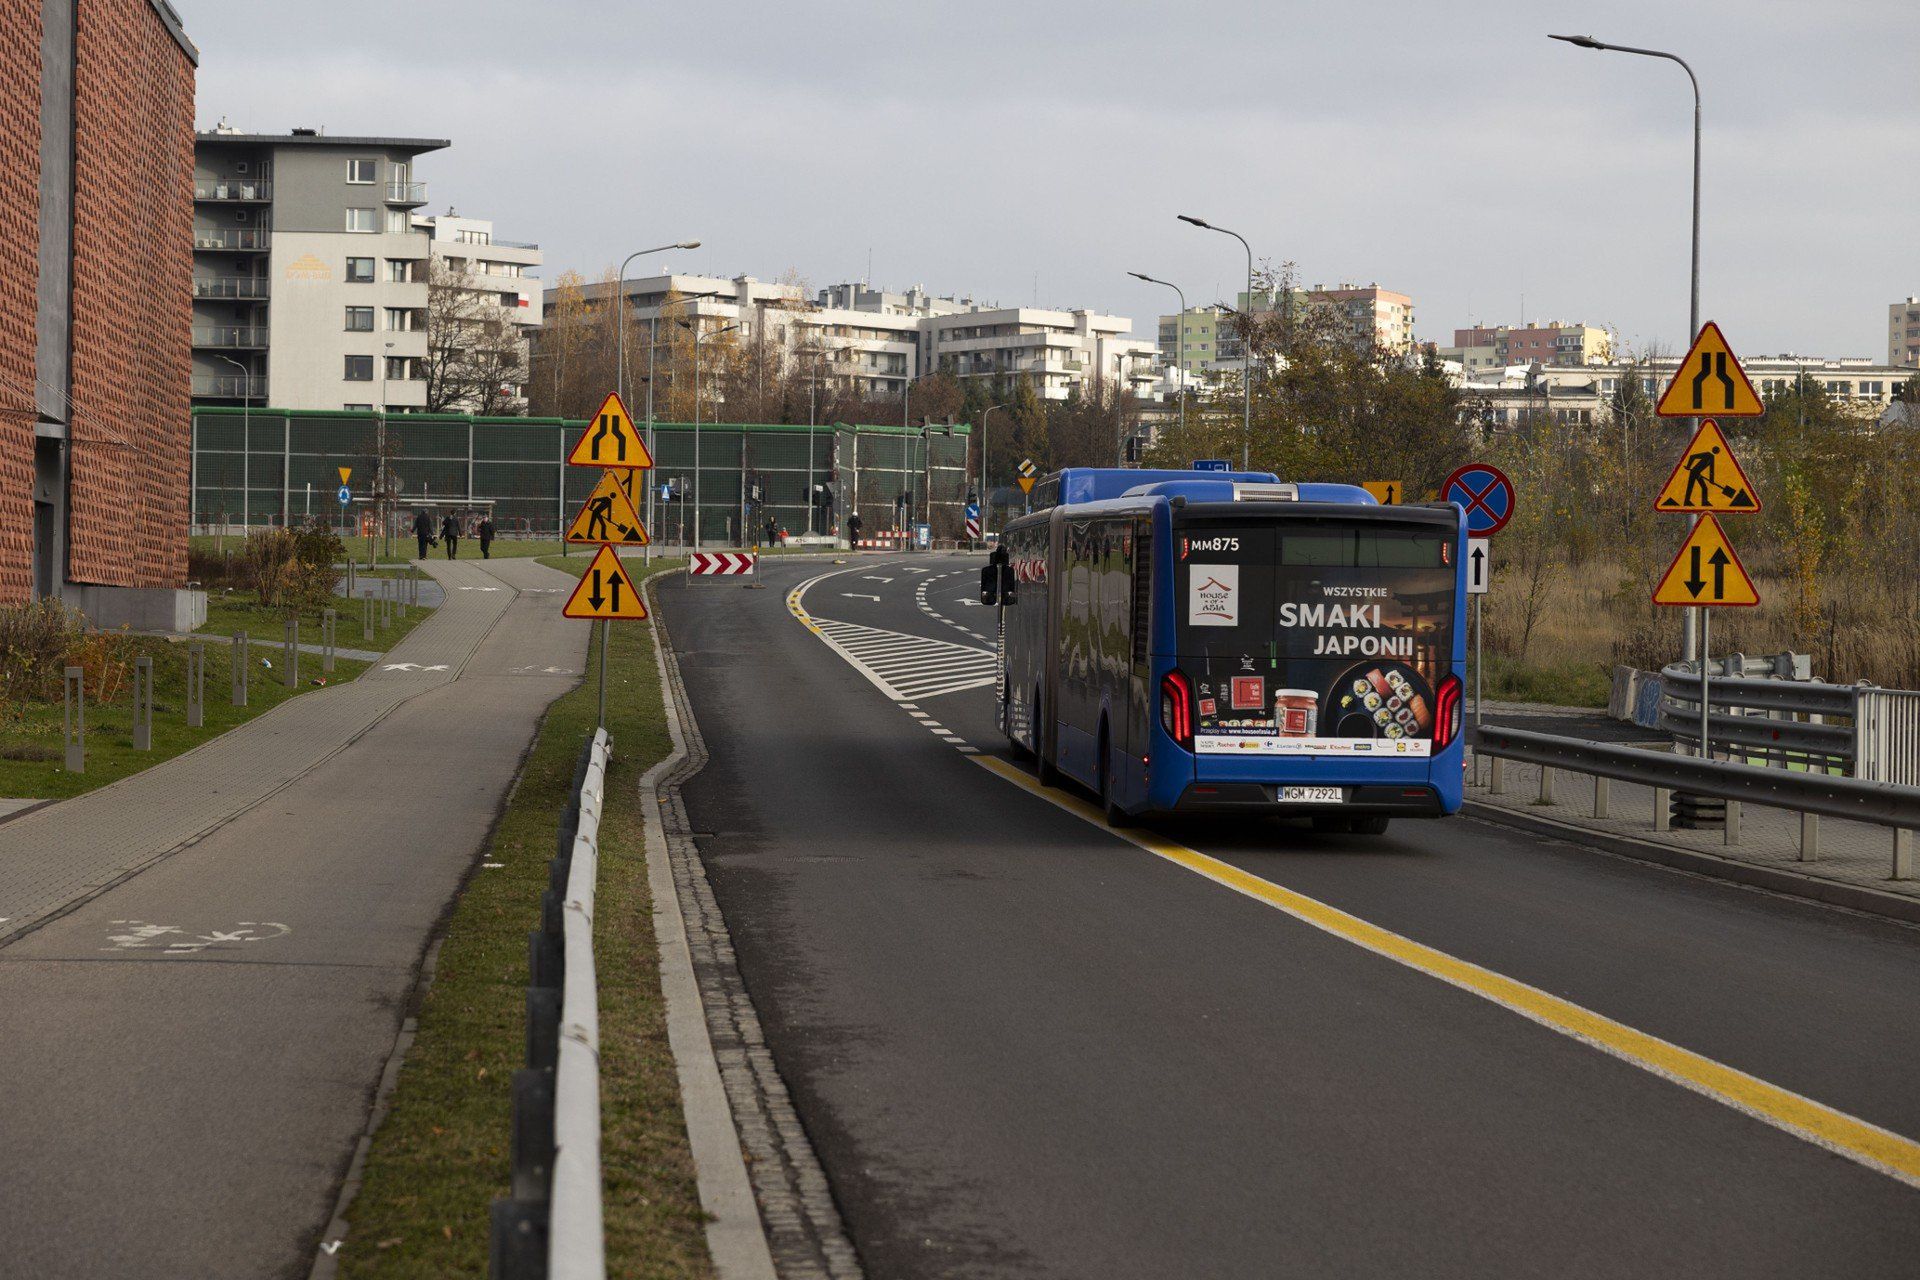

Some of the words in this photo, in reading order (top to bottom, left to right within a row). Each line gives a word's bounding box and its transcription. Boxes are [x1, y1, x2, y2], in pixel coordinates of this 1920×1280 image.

[1191, 537, 1239, 551] MM875
[1323, 586, 1387, 597] WSZYSTKIE
[1279, 602, 1380, 628] SMAKI
[1313, 635, 1413, 656] JAPONII
[1284, 787, 1306, 799] WGM
[1308, 788, 1341, 799] 7292L
